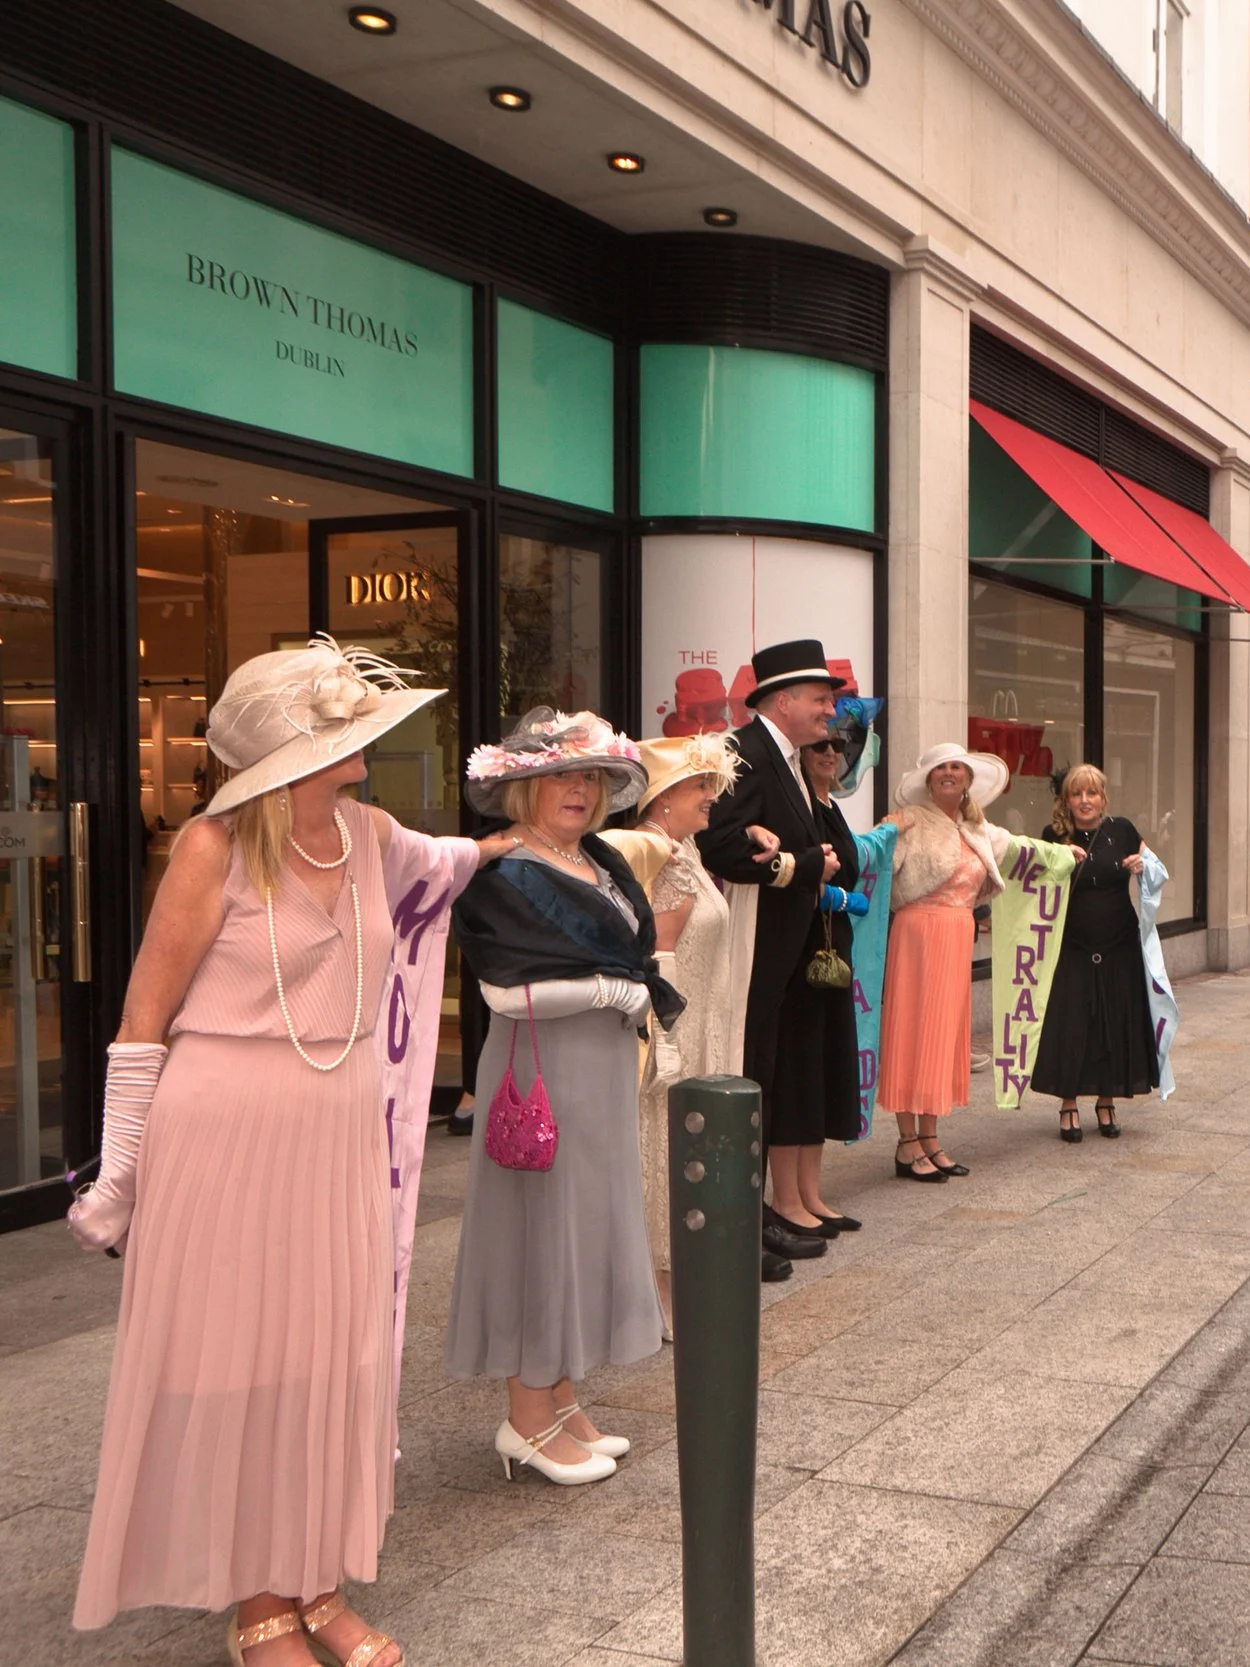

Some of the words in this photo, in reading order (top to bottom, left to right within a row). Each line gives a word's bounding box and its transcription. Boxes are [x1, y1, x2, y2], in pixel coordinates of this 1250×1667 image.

[185, 252, 300, 318] BROWN
[306, 295, 418, 358] THOMAS
[275, 340, 346, 378] DUBLIN
[345, 571, 430, 605] DIOR
[678, 650, 718, 665] THE
[995, 846, 1062, 1110] NEUTRALITY
